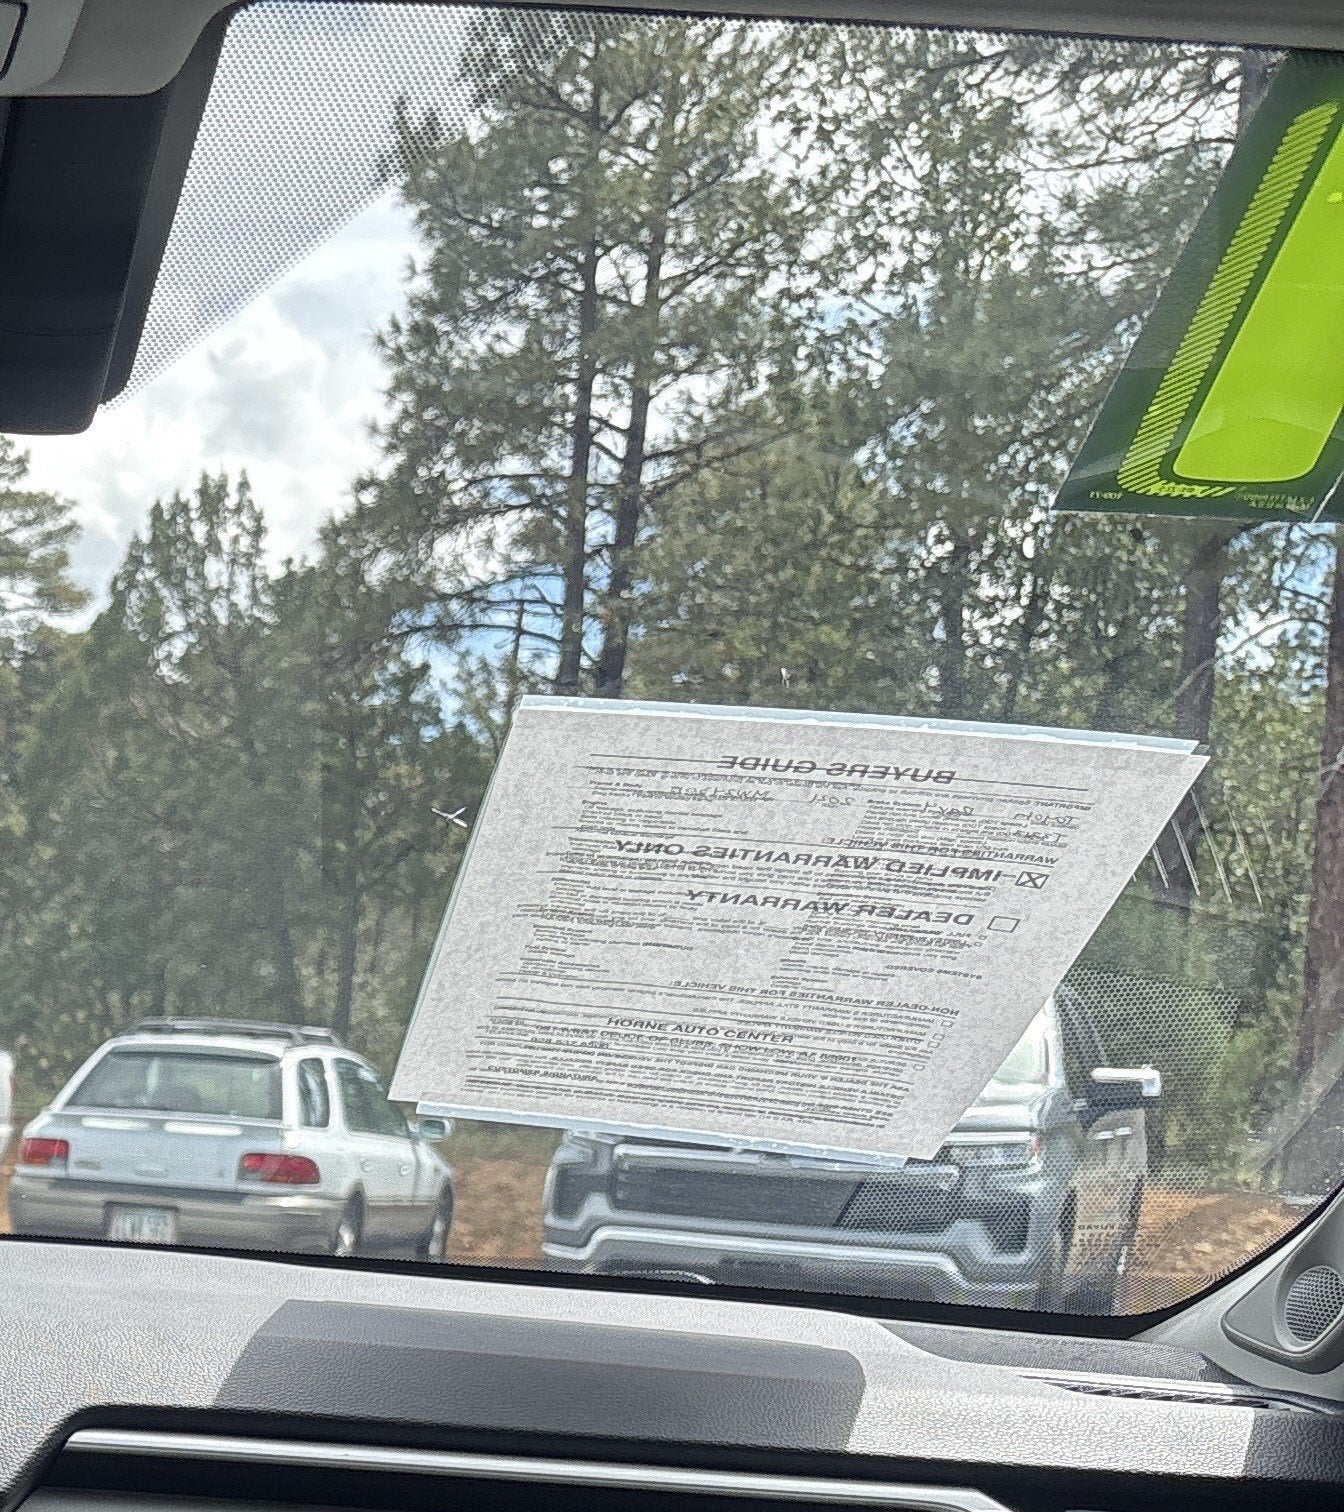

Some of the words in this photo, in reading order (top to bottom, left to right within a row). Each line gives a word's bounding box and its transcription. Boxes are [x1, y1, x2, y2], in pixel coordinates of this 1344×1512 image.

[606, 1016, 669, 1032] HORNE
[670, 1024, 720, 1038] AUTO
[722, 1030, 795, 1045] CENTER
